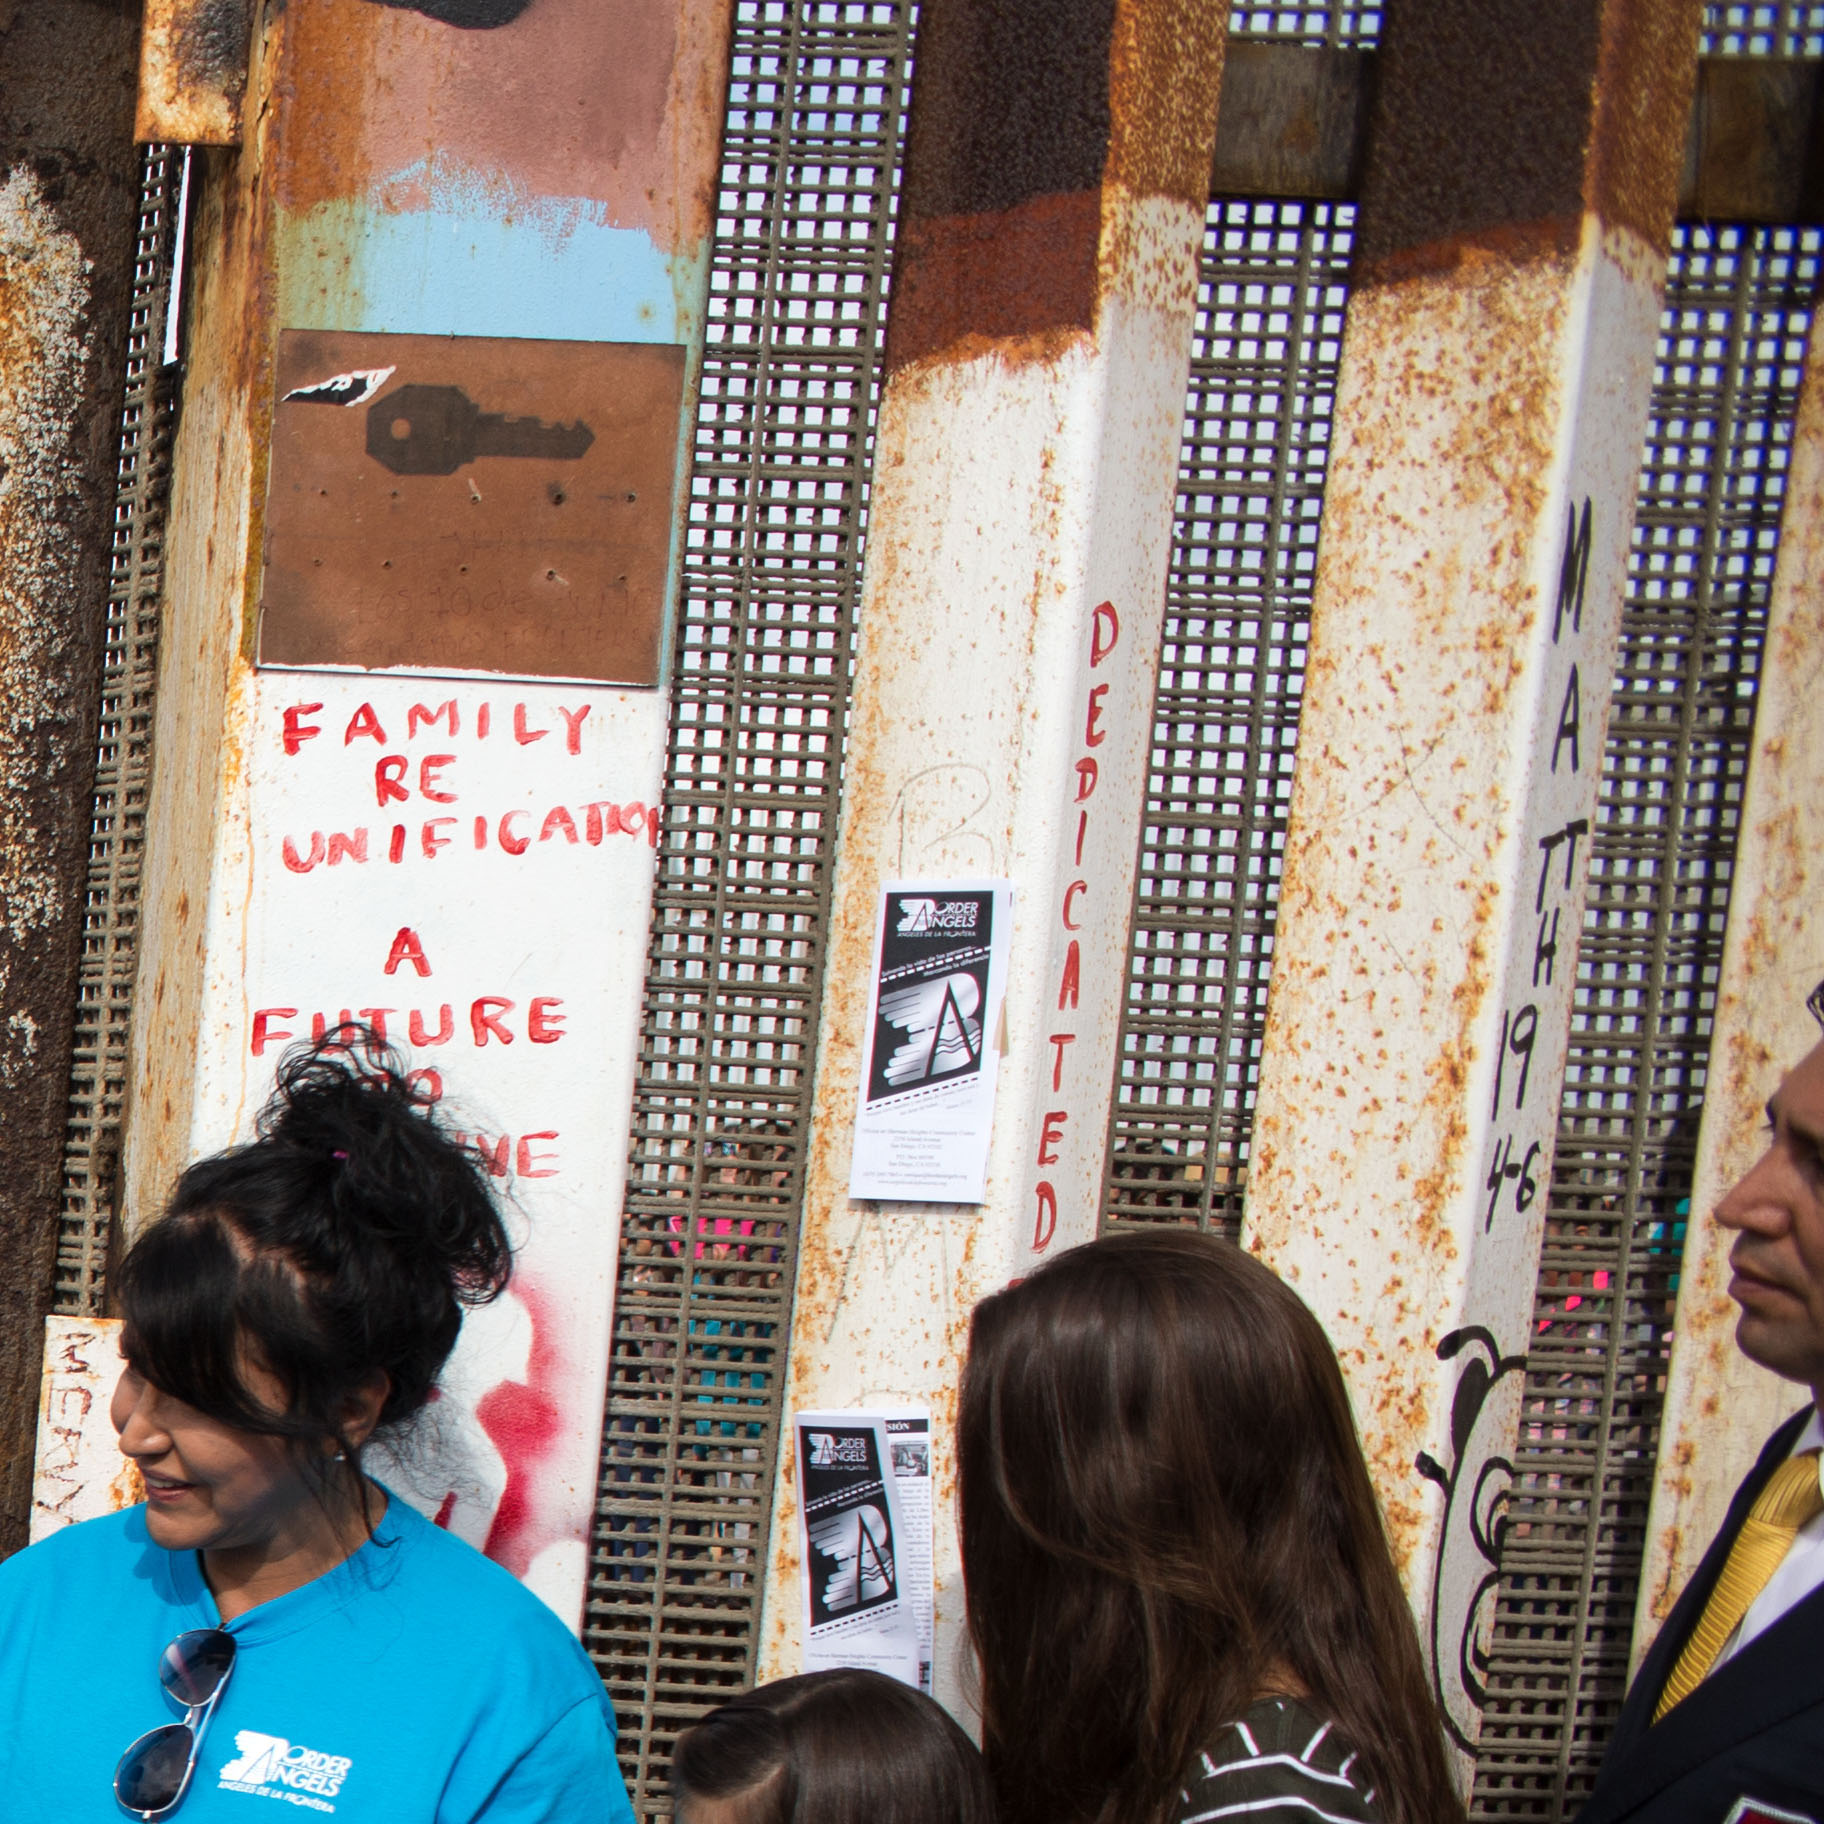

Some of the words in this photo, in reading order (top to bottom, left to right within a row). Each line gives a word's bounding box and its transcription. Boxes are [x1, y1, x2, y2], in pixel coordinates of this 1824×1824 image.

[282, 699, 592, 756] FAMILY
[374, 754, 459, 808] RE
[383, 926, 434, 978] A
[1031, 600, 1120, 1252] DEDICATED
[251, 995, 568, 1058] FUTURE
[255, 1785, 272, 1797] DE
[269, 1789, 284, 1800] LA
